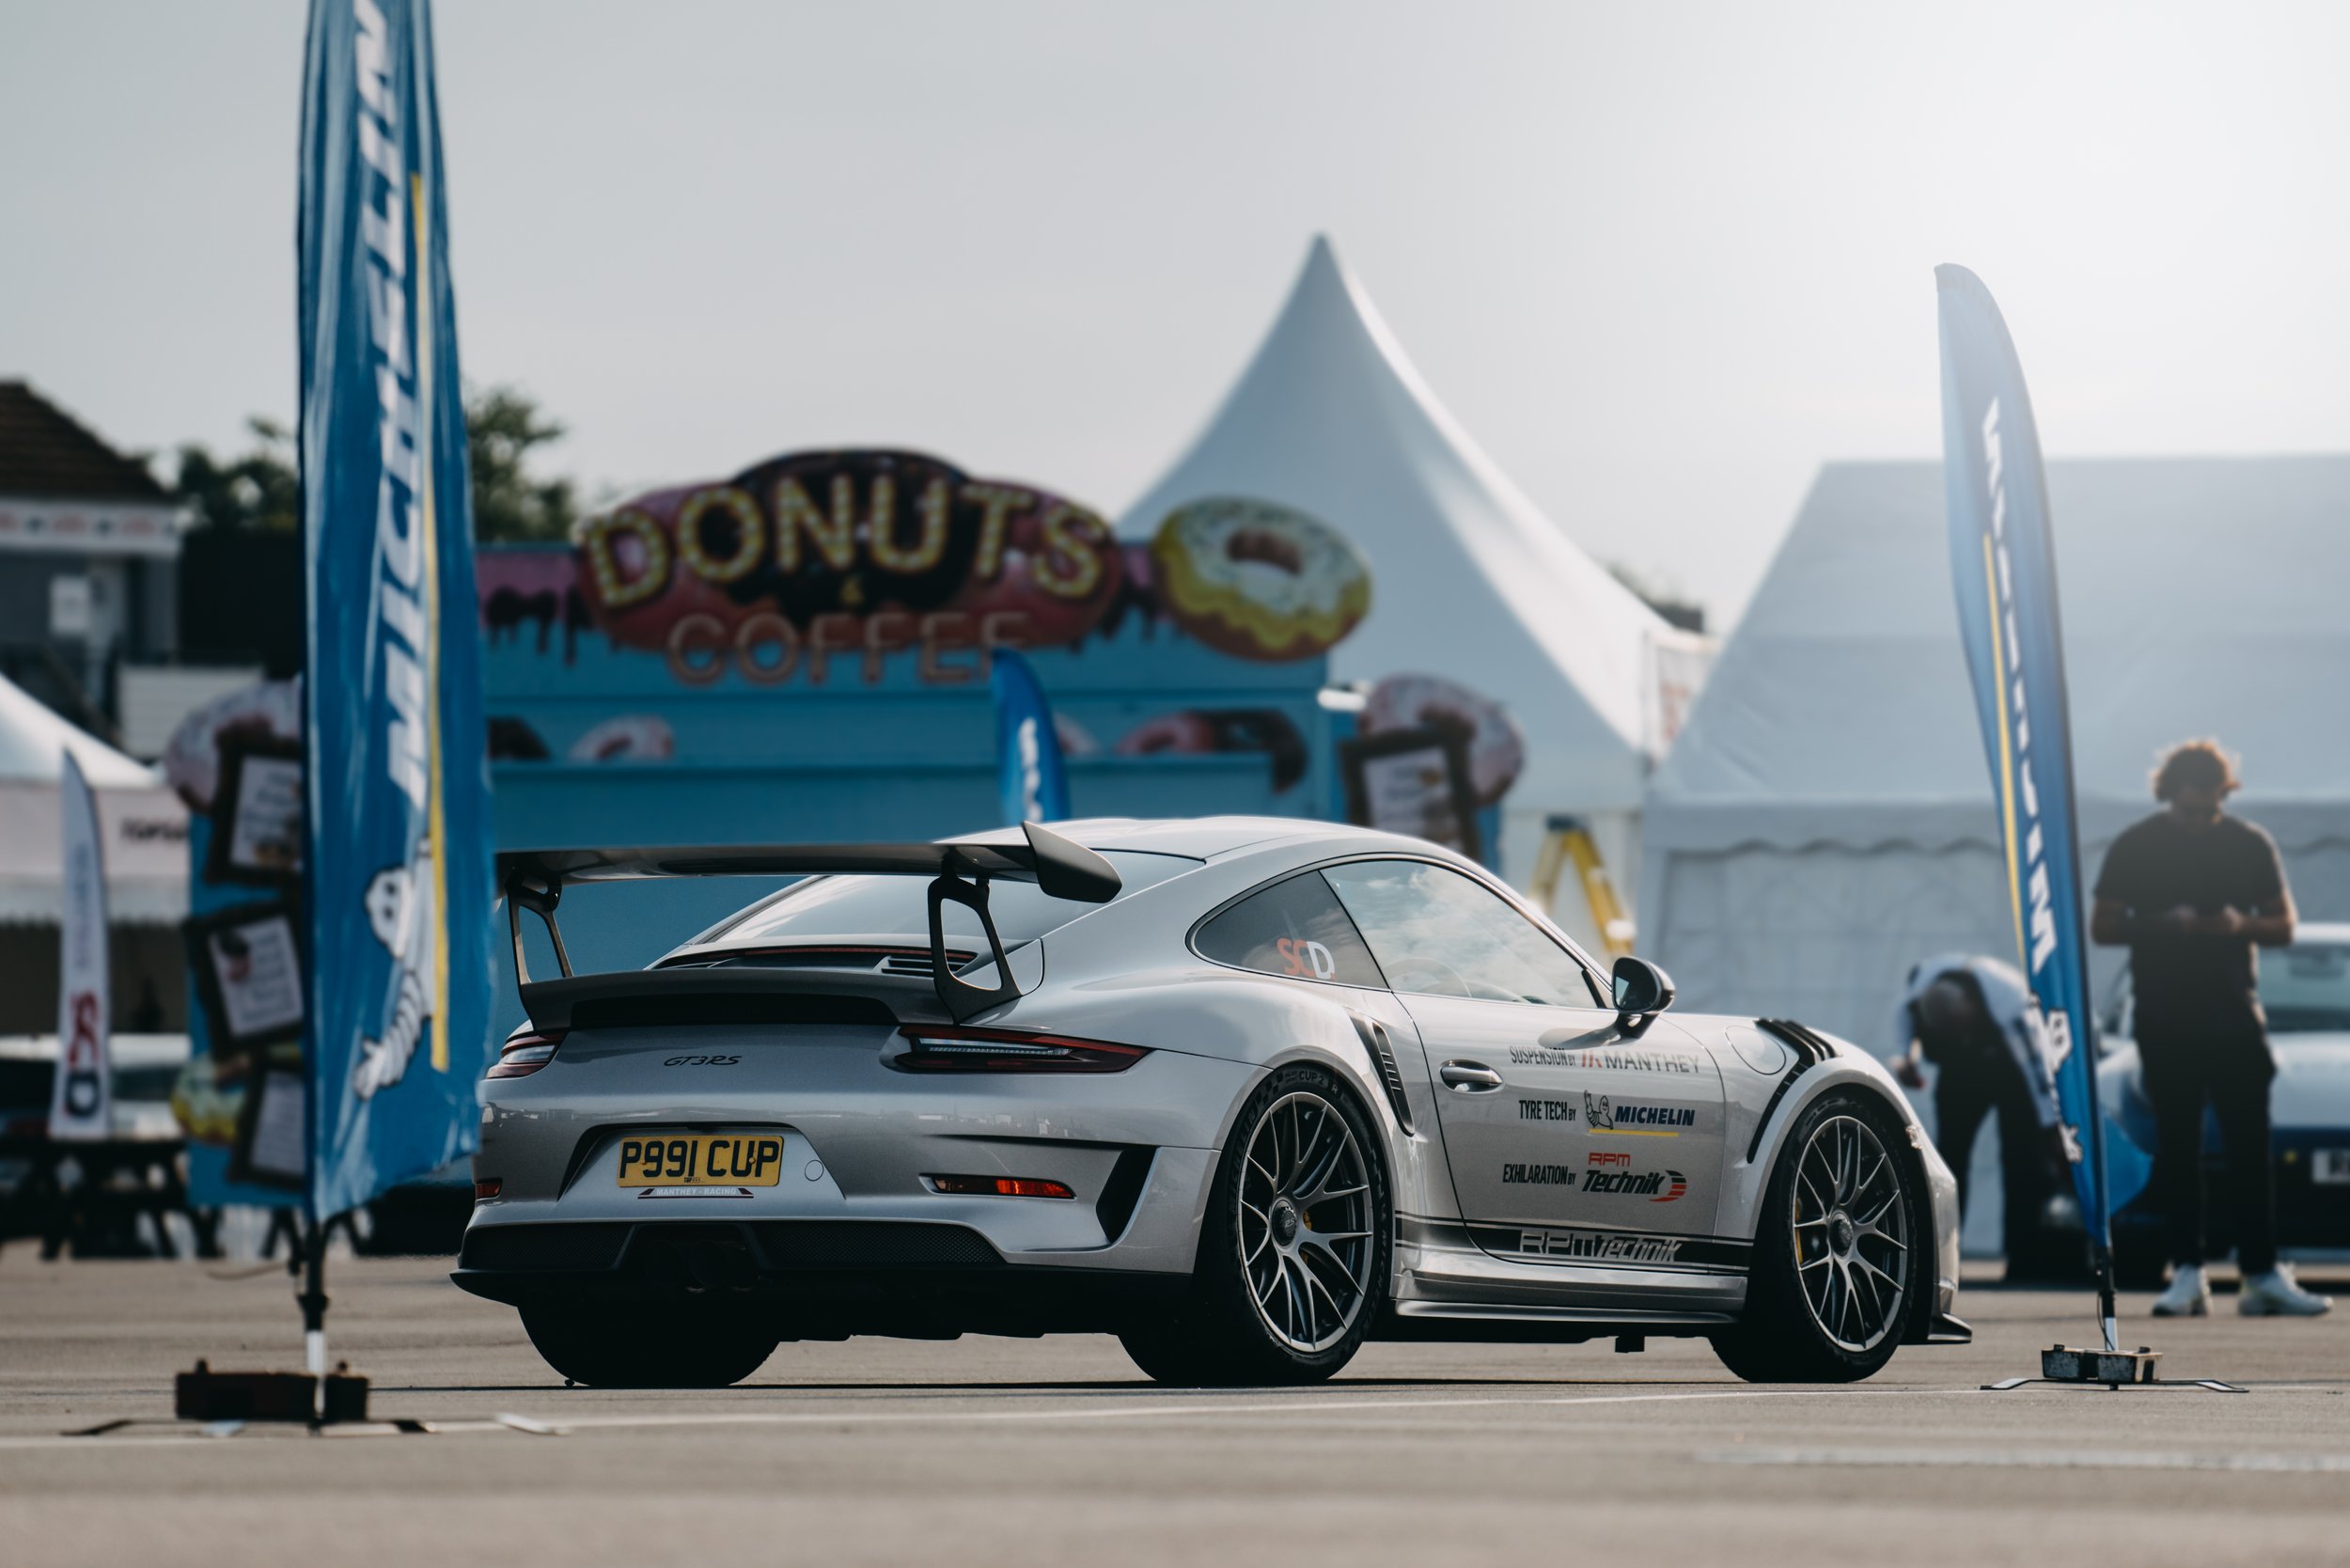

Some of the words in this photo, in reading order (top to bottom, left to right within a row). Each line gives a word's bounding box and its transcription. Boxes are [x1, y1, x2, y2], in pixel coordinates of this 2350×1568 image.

[583, 476, 1112, 607] DONUTS
[1509, 1045, 1568, 1067] SUSPENSION
[1604, 1050, 1700, 1074] MANTHEY
[1519, 1100, 1543, 1121] TYRE
[1544, 1101, 1568, 1121] TECH
[1568, 1108, 1576, 1121] BY
[1615, 1105, 1695, 1126] MICHELIN
[619, 1140, 698, 1179] P991
[707, 1140, 780, 1178] CUP
[1588, 1152, 1631, 1168] RPM
[1502, 1164, 1568, 1185] EXHILARATION
[1568, 1172, 1576, 1185] BY
[1582, 1169, 1667, 1195] Technik
[656, 1188, 697, 1197] MANTHEY
